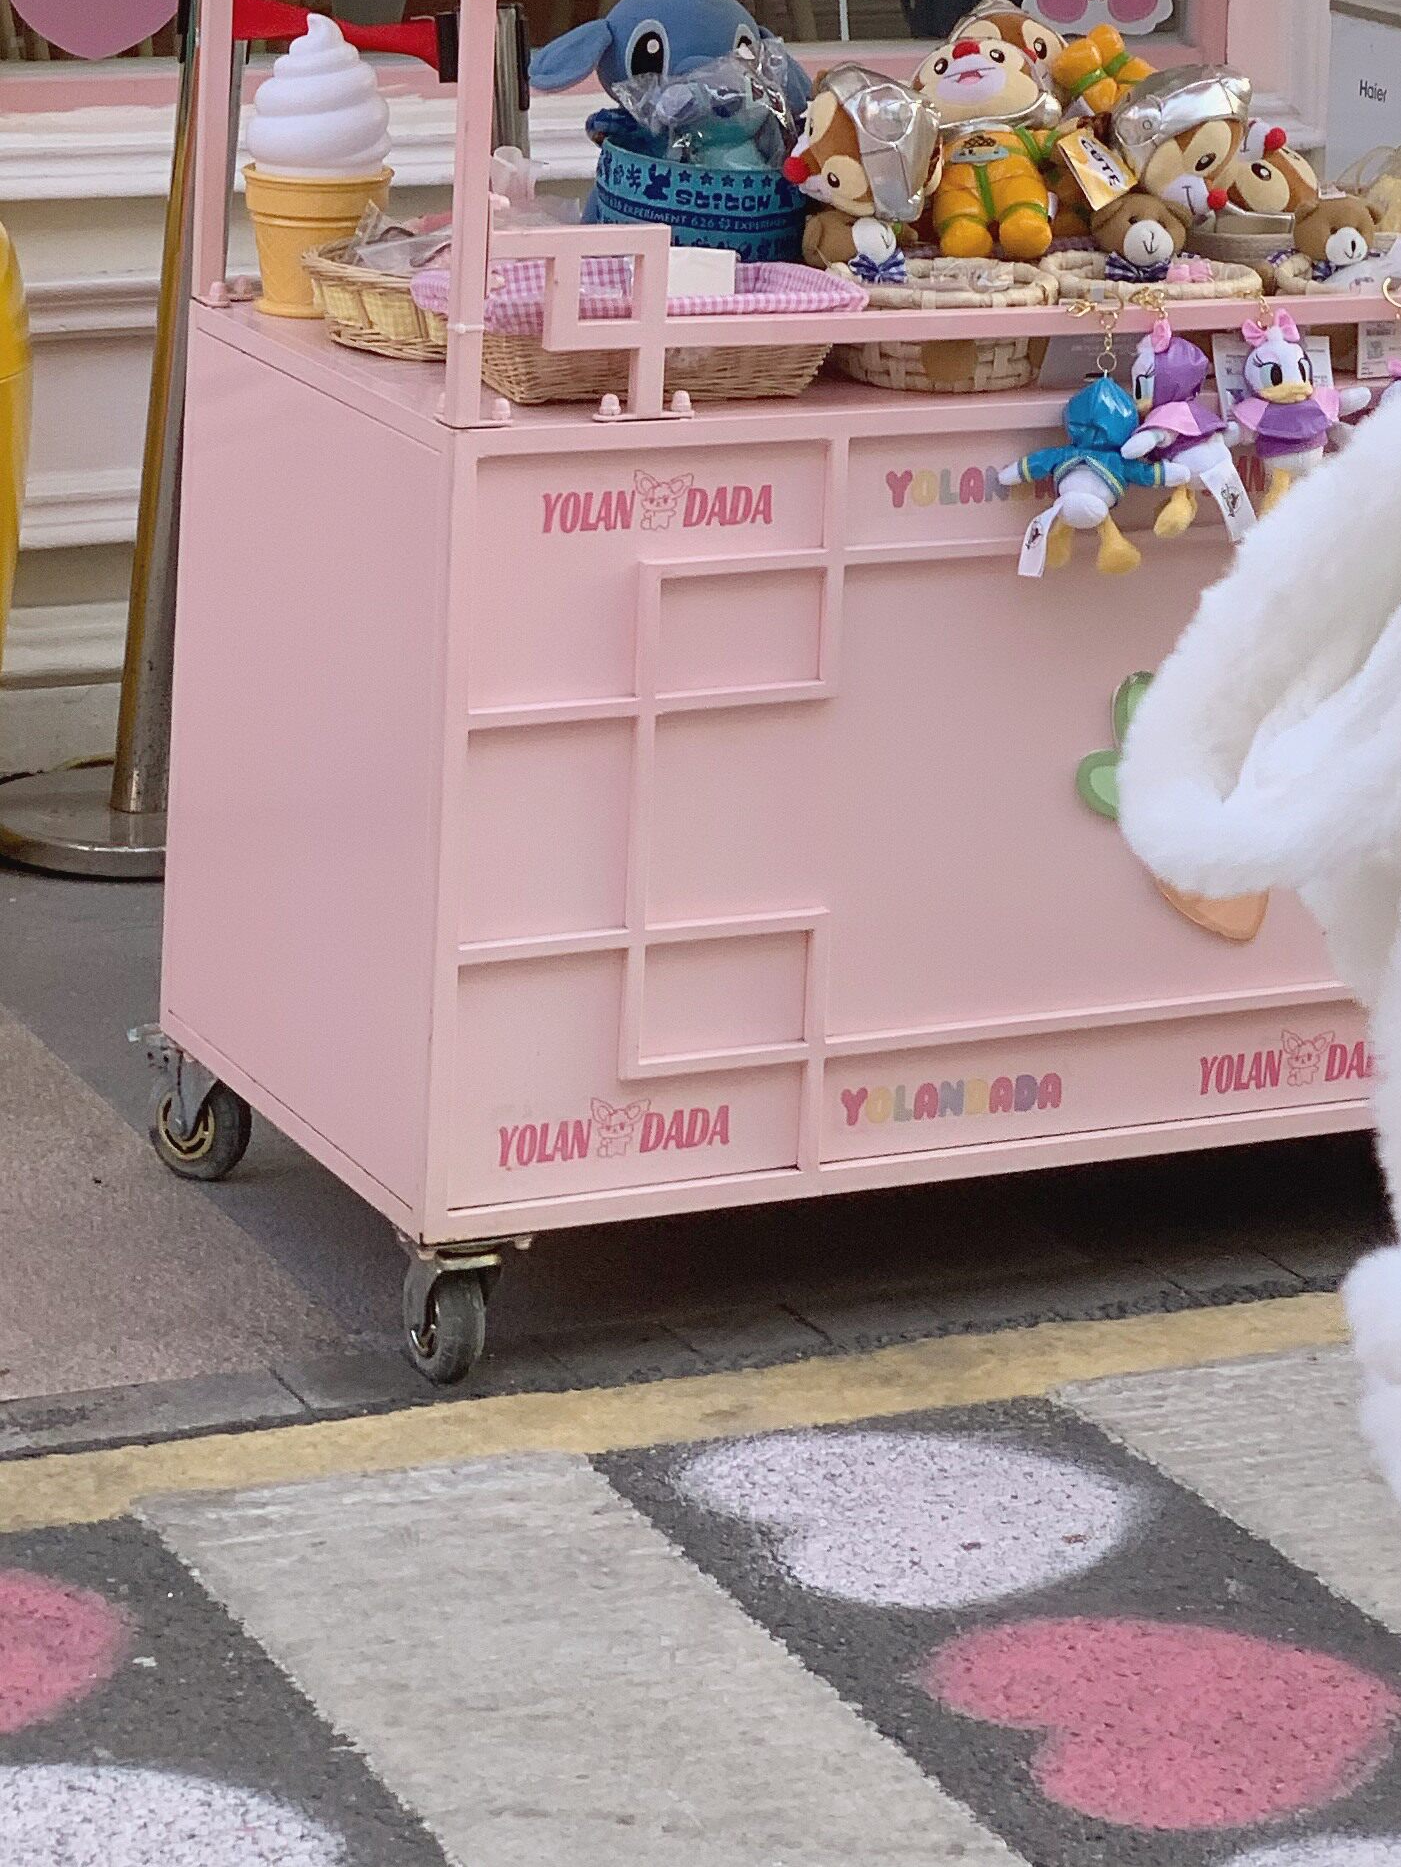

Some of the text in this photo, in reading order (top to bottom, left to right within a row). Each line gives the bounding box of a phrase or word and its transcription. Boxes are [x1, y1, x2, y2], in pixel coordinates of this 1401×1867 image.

[1359, 79, 1387, 103] Haier
[691, 216, 715, 229] 626
[541, 483, 773, 534] YOLAN DADA
[1200, 1040, 1373, 1096] YOLAN DA
[840, 1072, 1063, 1127] YOLANDADA
[499, 1104, 730, 1167] YOLAN DADA
